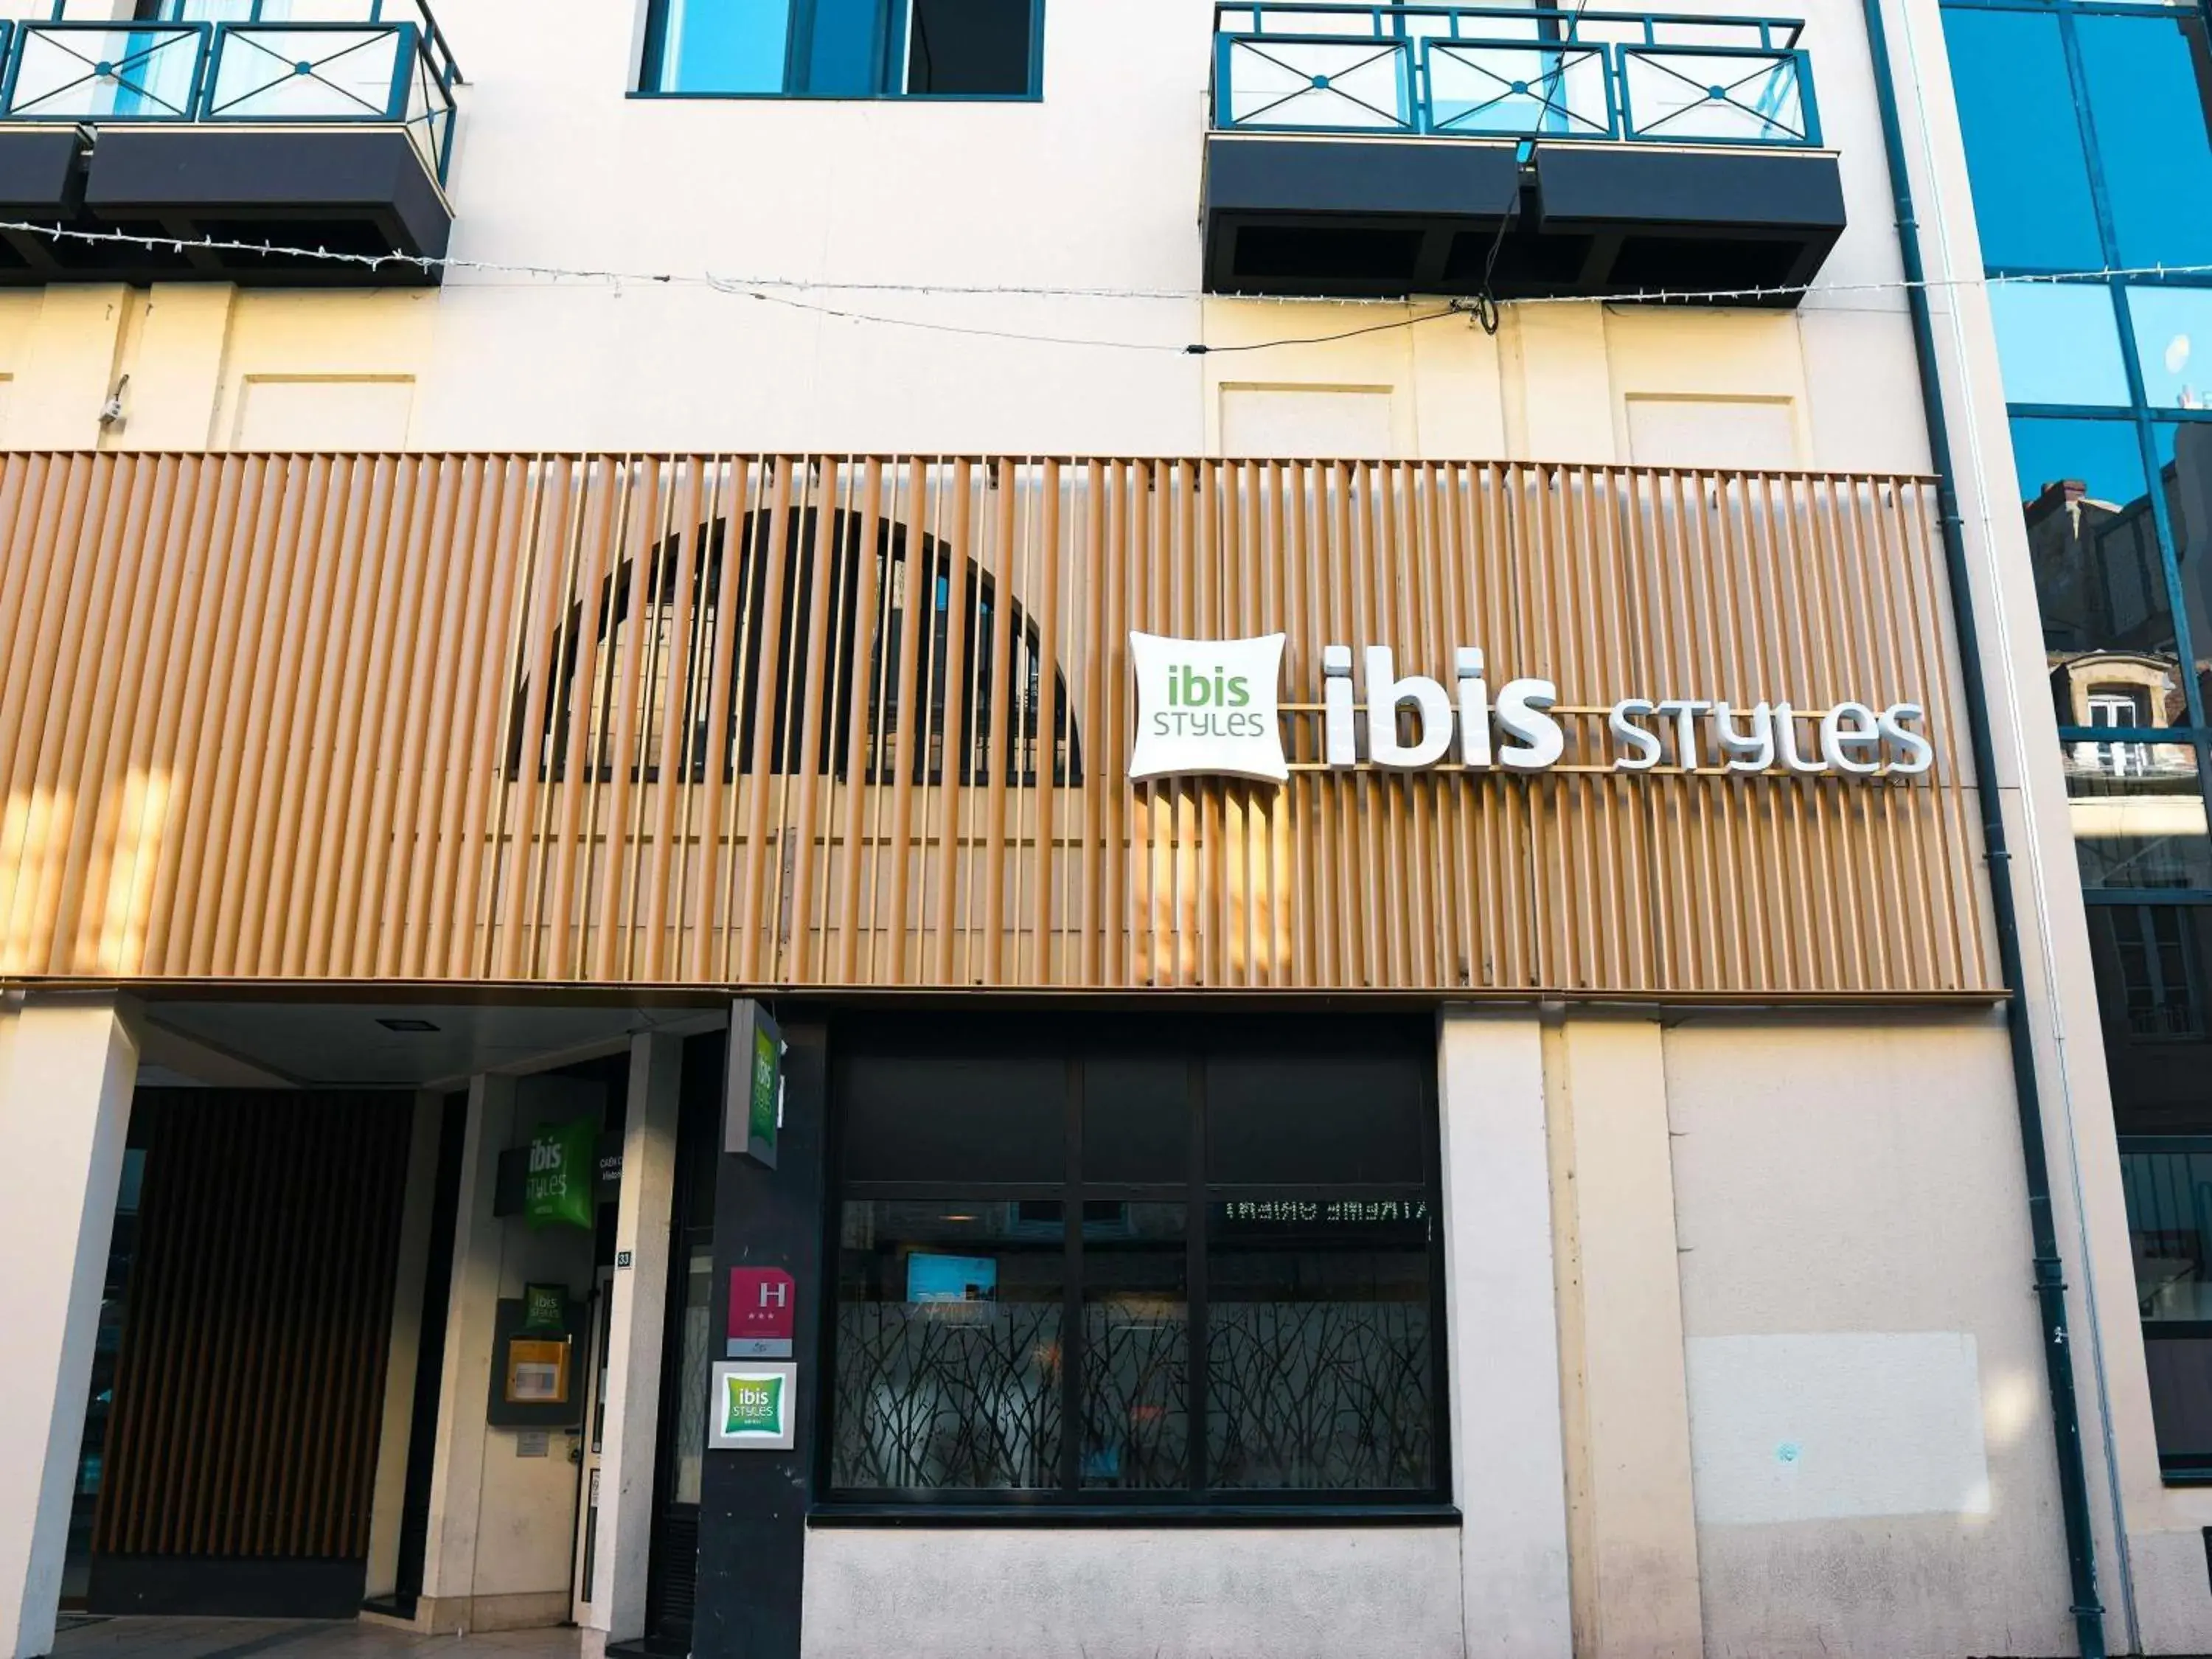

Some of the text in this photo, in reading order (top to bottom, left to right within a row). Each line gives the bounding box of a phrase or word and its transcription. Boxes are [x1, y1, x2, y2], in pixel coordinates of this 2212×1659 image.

[1167, 664, 1250, 706] ibis
[1324, 646, 1565, 773] ibis
[529, 1136, 562, 1172] ibis
[759, 1282, 787, 1307] H
[740, 1387, 769, 1405] ibis
